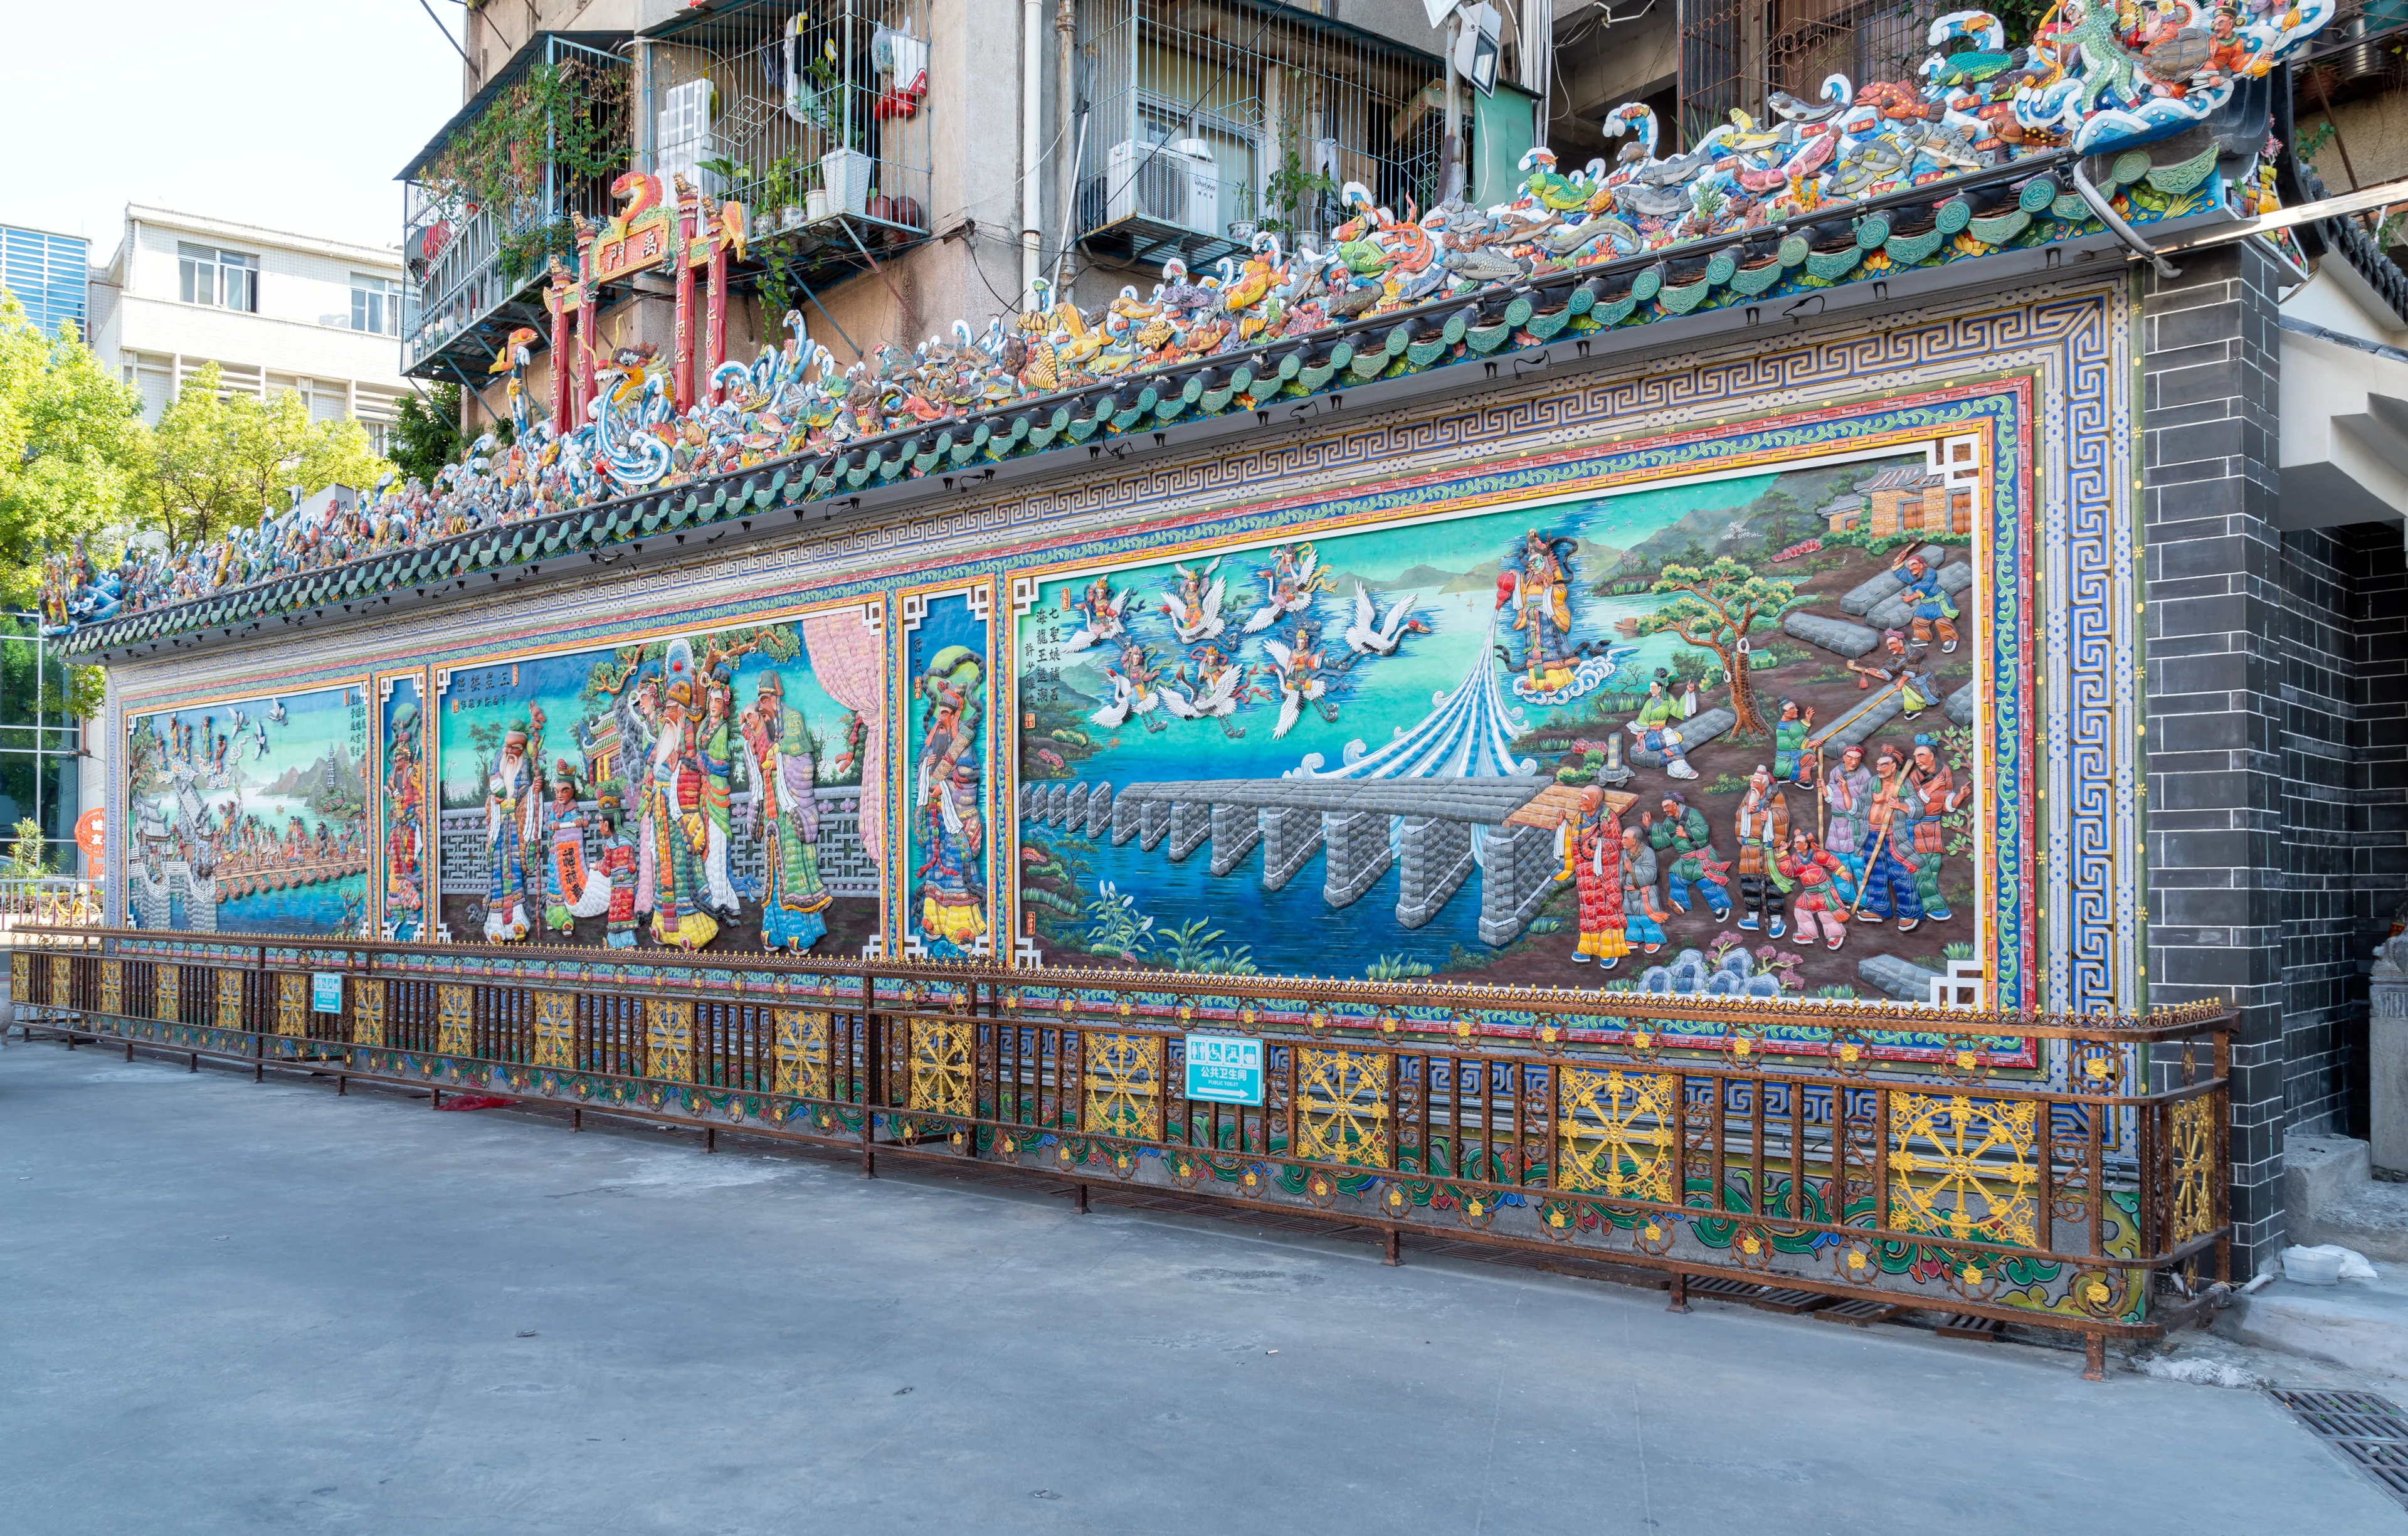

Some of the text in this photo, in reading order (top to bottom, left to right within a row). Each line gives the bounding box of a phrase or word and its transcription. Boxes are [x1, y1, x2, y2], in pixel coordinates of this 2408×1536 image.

[1956, 97, 1974, 109] 苏眉
[1200, 1066, 1247, 1081] 公共卫生间
